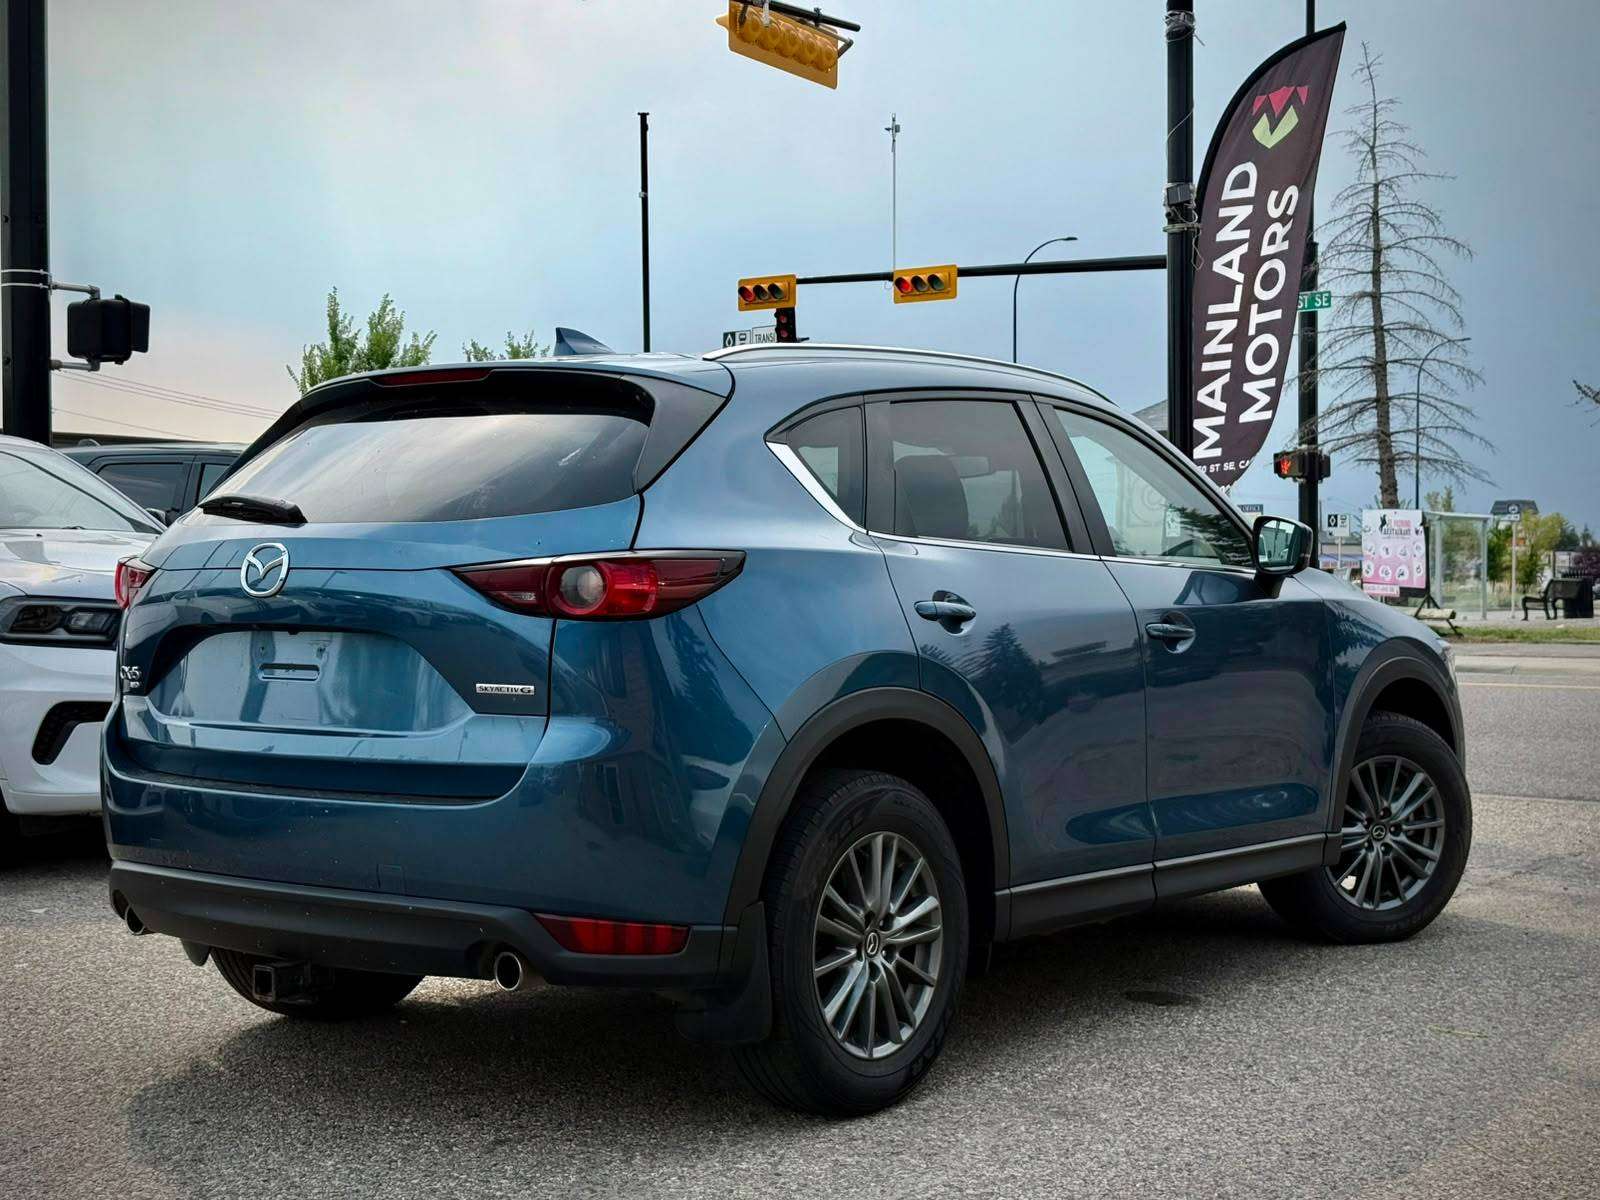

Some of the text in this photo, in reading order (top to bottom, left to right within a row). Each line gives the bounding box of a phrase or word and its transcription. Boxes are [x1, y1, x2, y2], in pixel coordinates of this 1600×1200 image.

[1193, 161, 1258, 459] MAINLAND
[1239, 185, 1299, 423] MOTORS
[1298, 292, 1330, 309] ST SE
[1209, 463, 1221, 473] ST
